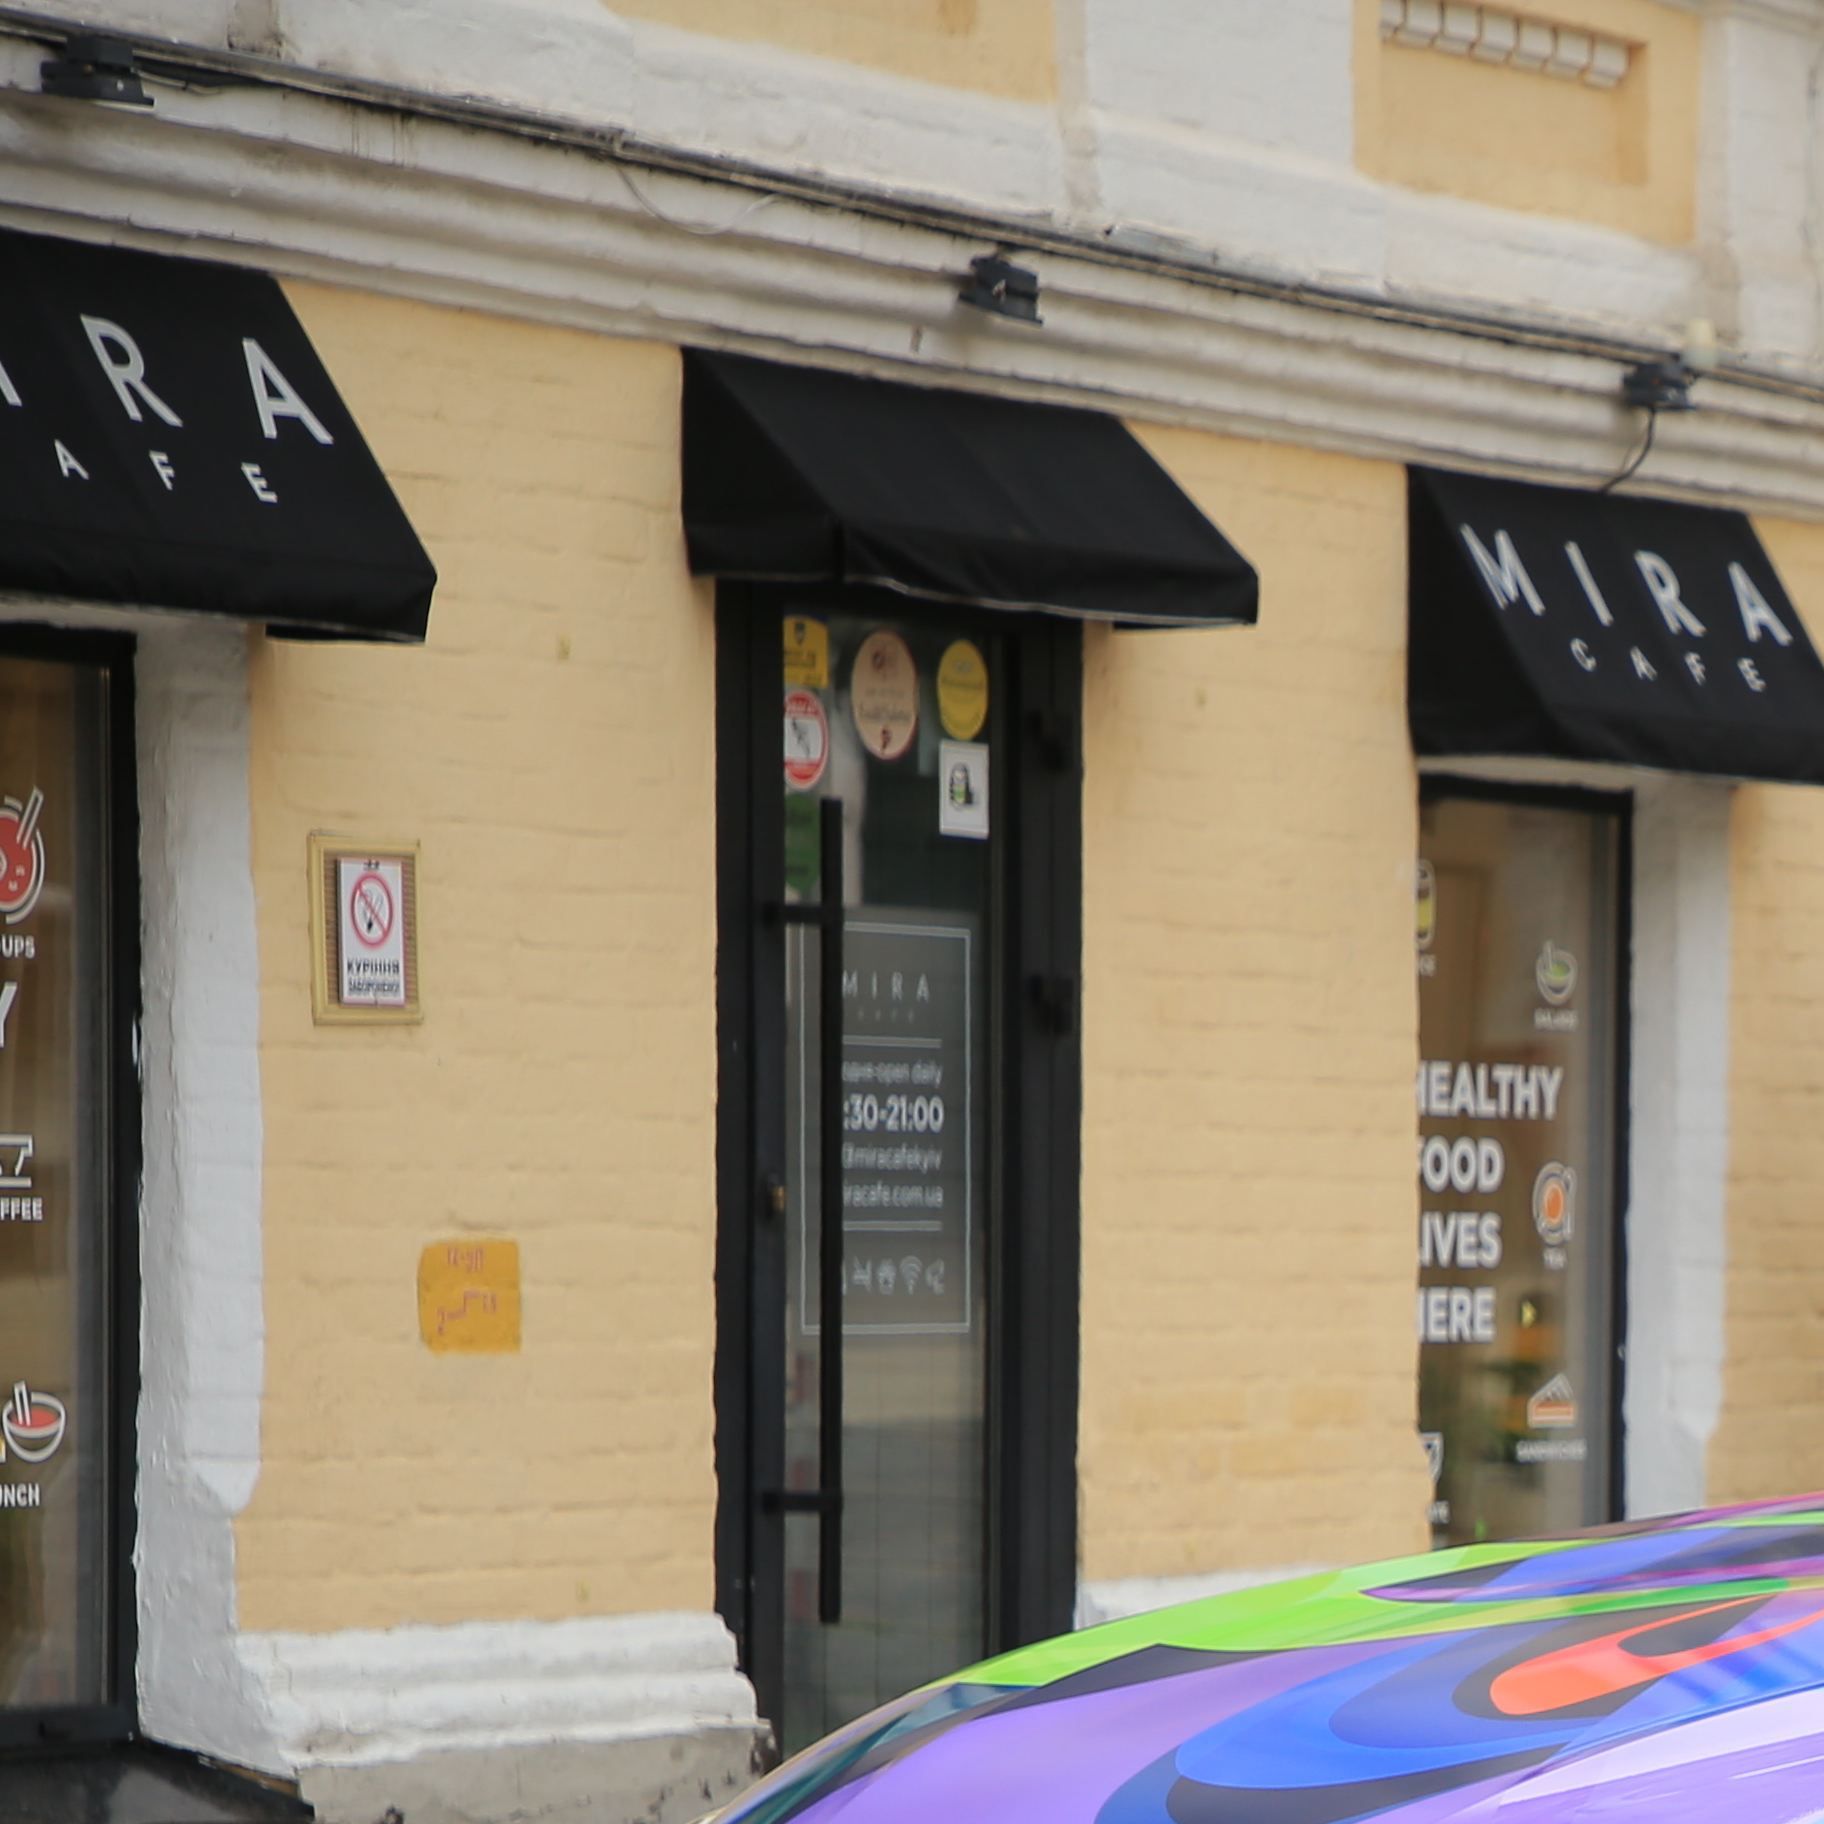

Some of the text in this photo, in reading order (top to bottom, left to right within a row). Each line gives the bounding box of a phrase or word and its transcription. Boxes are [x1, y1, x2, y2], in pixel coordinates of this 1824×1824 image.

[0, 313, 334, 445] RA
[54, 439, 278, 503] AFE
[1459, 522, 1794, 646] MIRA
[1570, 638, 1766, 692] CAFE
[0, 934, 36, 959] UPS
[842, 968, 931, 1003] MIRA
[843, 1093, 944, 1133] :30-21:00
[0, 1197, 43, 1221] FFEE
[1417, 1210, 1502, 1269] IVES
[0, 1483, 41, 1507] NCH
